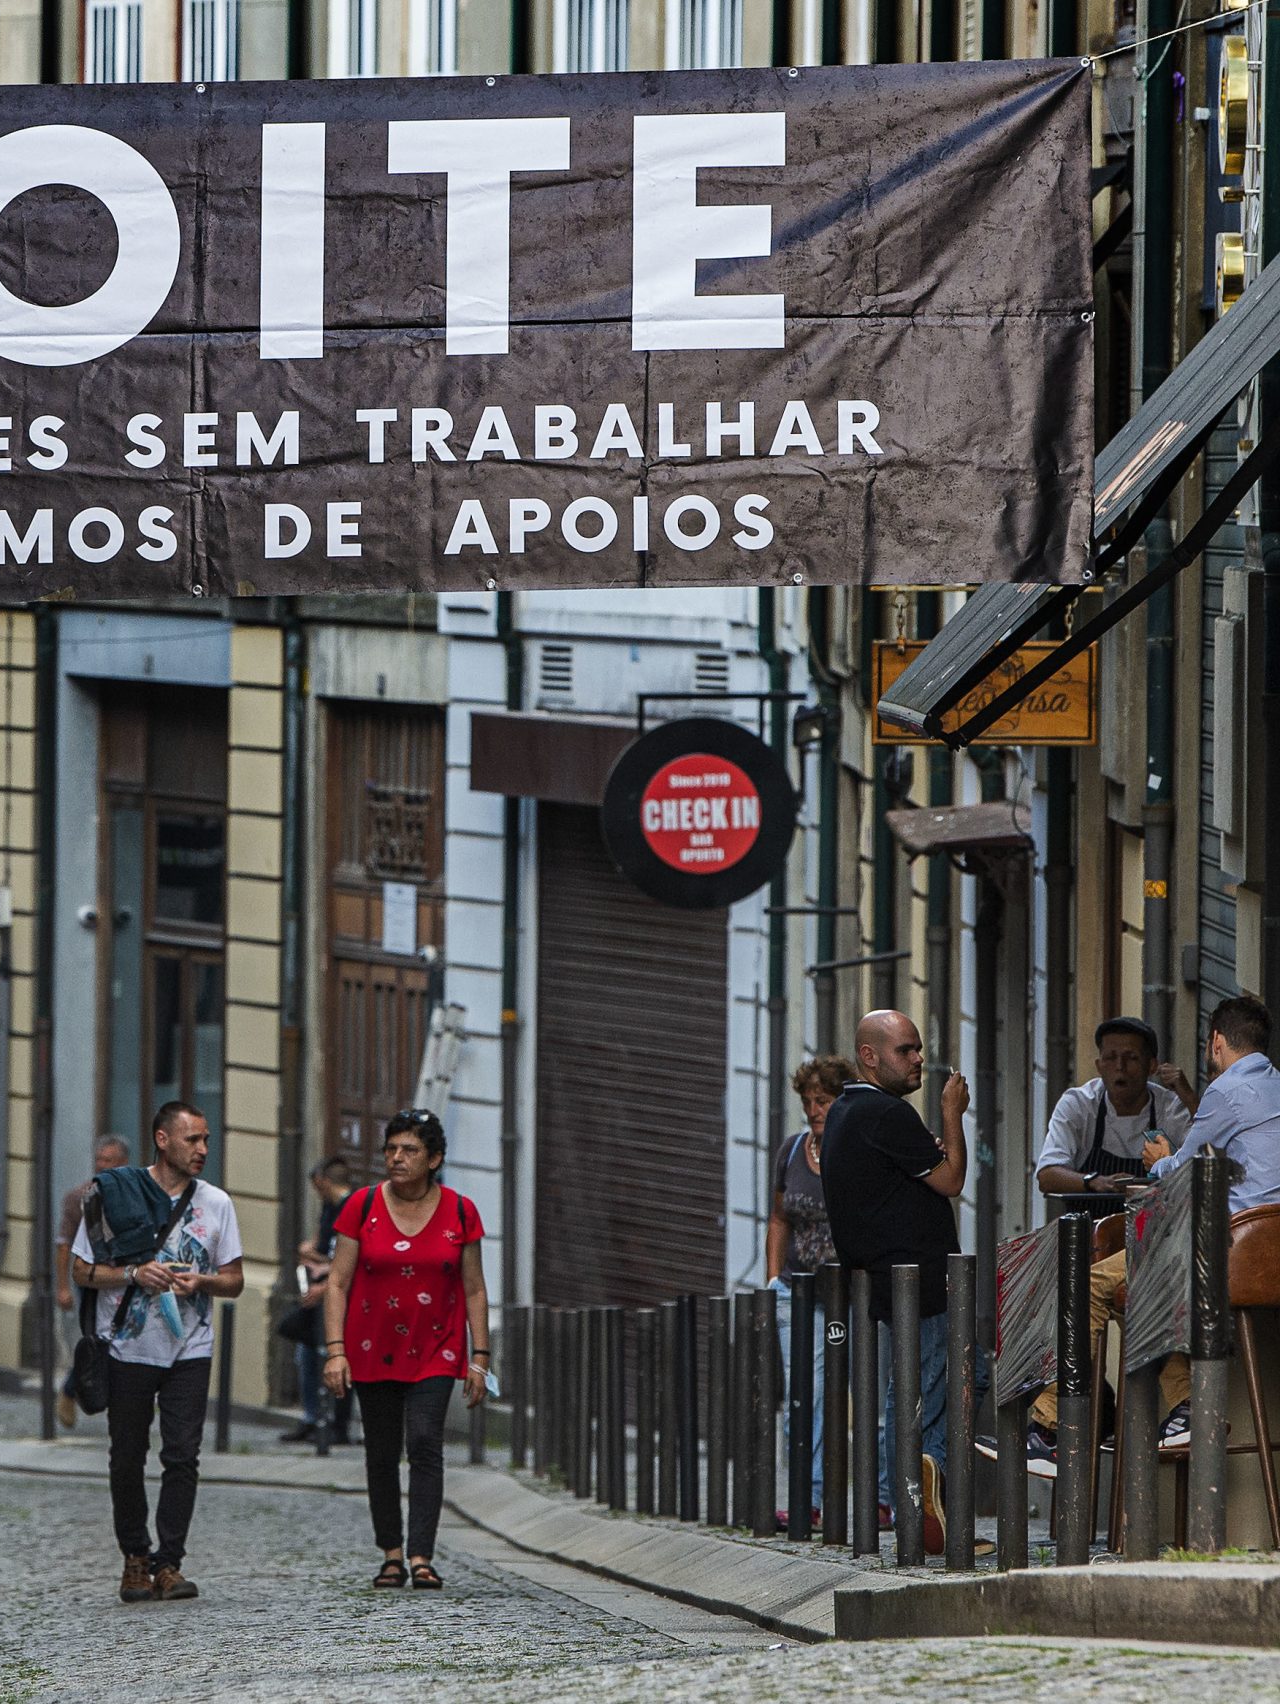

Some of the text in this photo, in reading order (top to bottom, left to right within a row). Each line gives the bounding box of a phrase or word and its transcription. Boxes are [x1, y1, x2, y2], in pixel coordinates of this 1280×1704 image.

[125, 411, 299, 468] SEM
[356, 400, 884, 462] TRABALHAR
[265, 502, 361, 558] DE
[444, 494, 773, 554] APOIOS
[644, 796, 759, 831] CHECK IN
